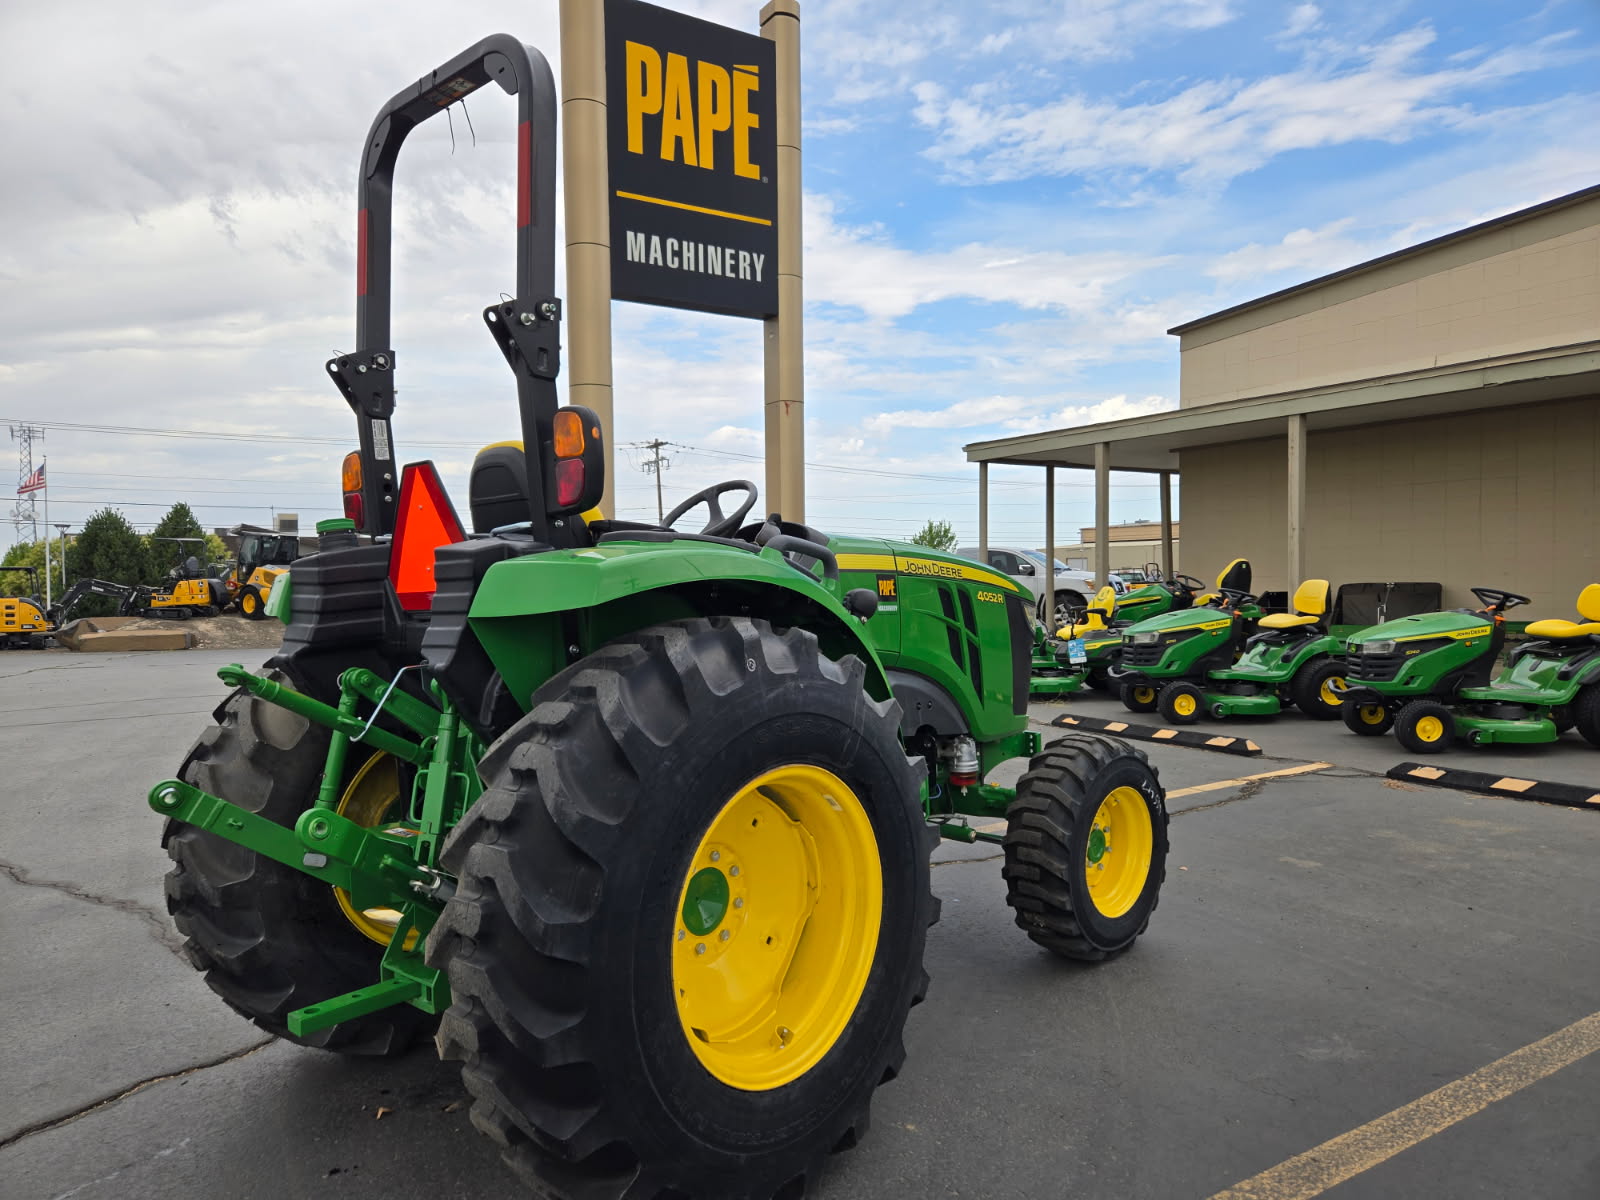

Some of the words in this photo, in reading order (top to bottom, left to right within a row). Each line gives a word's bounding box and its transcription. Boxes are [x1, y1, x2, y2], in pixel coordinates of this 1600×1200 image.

[625, 40, 760, 181] PAPÉ
[626, 231, 765, 282] MACHINERY
[904, 560, 931, 575] JOHN
[932, 563, 962, 578] DEERE
[977, 590, 1004, 604] 4052R
